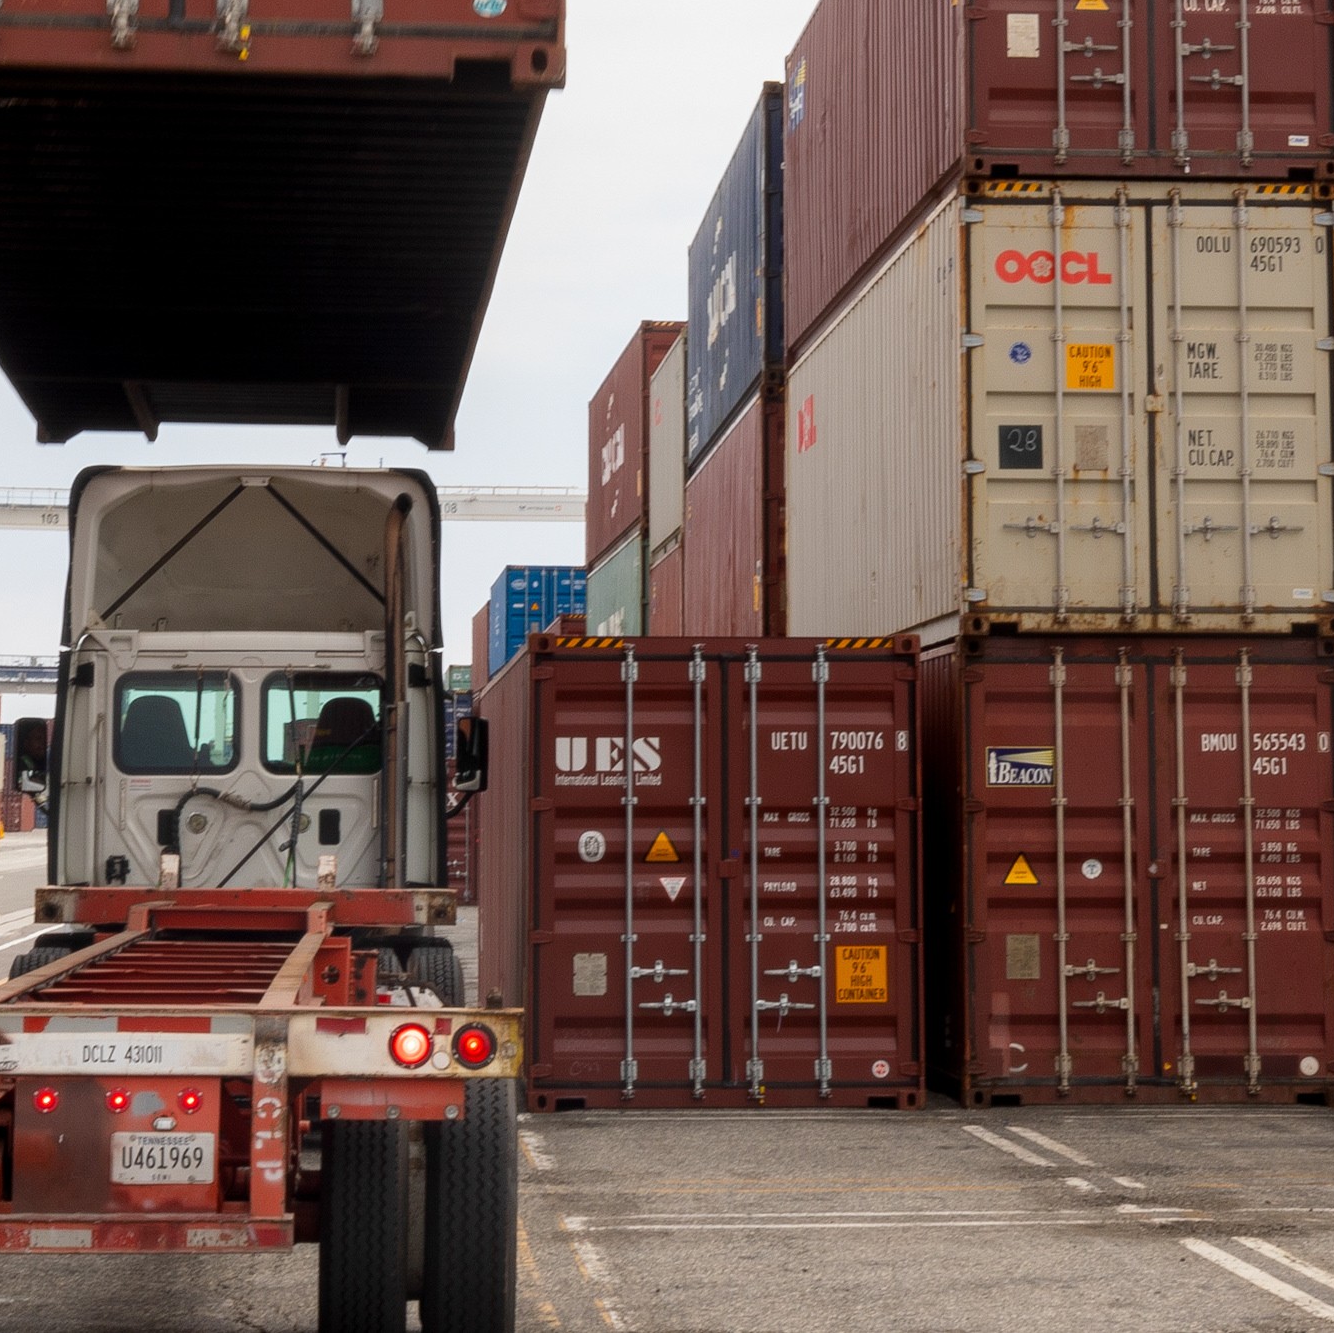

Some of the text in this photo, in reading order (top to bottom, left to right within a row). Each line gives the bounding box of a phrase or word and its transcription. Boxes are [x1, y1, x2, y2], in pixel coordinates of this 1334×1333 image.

[1196, 236, 1324, 254] OOLU 690593 0
[995, 250, 1112, 284] OOCL
[1250, 256, 1283, 272] 45G1
[1069, 346, 1111, 359] CAUTION
[1187, 343, 1219, 360] MGW.
[1187, 363, 1222, 379] TARE.
[1079, 376, 1102, 388] HIGH
[1007, 430, 1037, 451] 28
[1189, 431, 1215, 447] NET.
[41, 513, 59, 524] 103
[772, 732, 907, 750] UETU 790076 8
[1201, 733, 1328, 751] BMOU 565543 0
[556, 737, 661, 771] UES
[830, 755, 864, 774] 45G1
[1253, 757, 1287, 775] 45G1
[555, 773, 661, 788] International Leasing Limited
[998, 763, 1052, 784] BEACON
[1193, 847, 1210, 856] TARE
[842, 948, 879, 961] CAUTION
[850, 975, 872, 987] HIGH
[839, 988, 885, 1000] CONTAINER
[83, 1046, 162, 1063] DCLZ 431011
[137, 1136, 191, 1146] TENNESSEE
[121, 1147, 203, 1169] U461969
